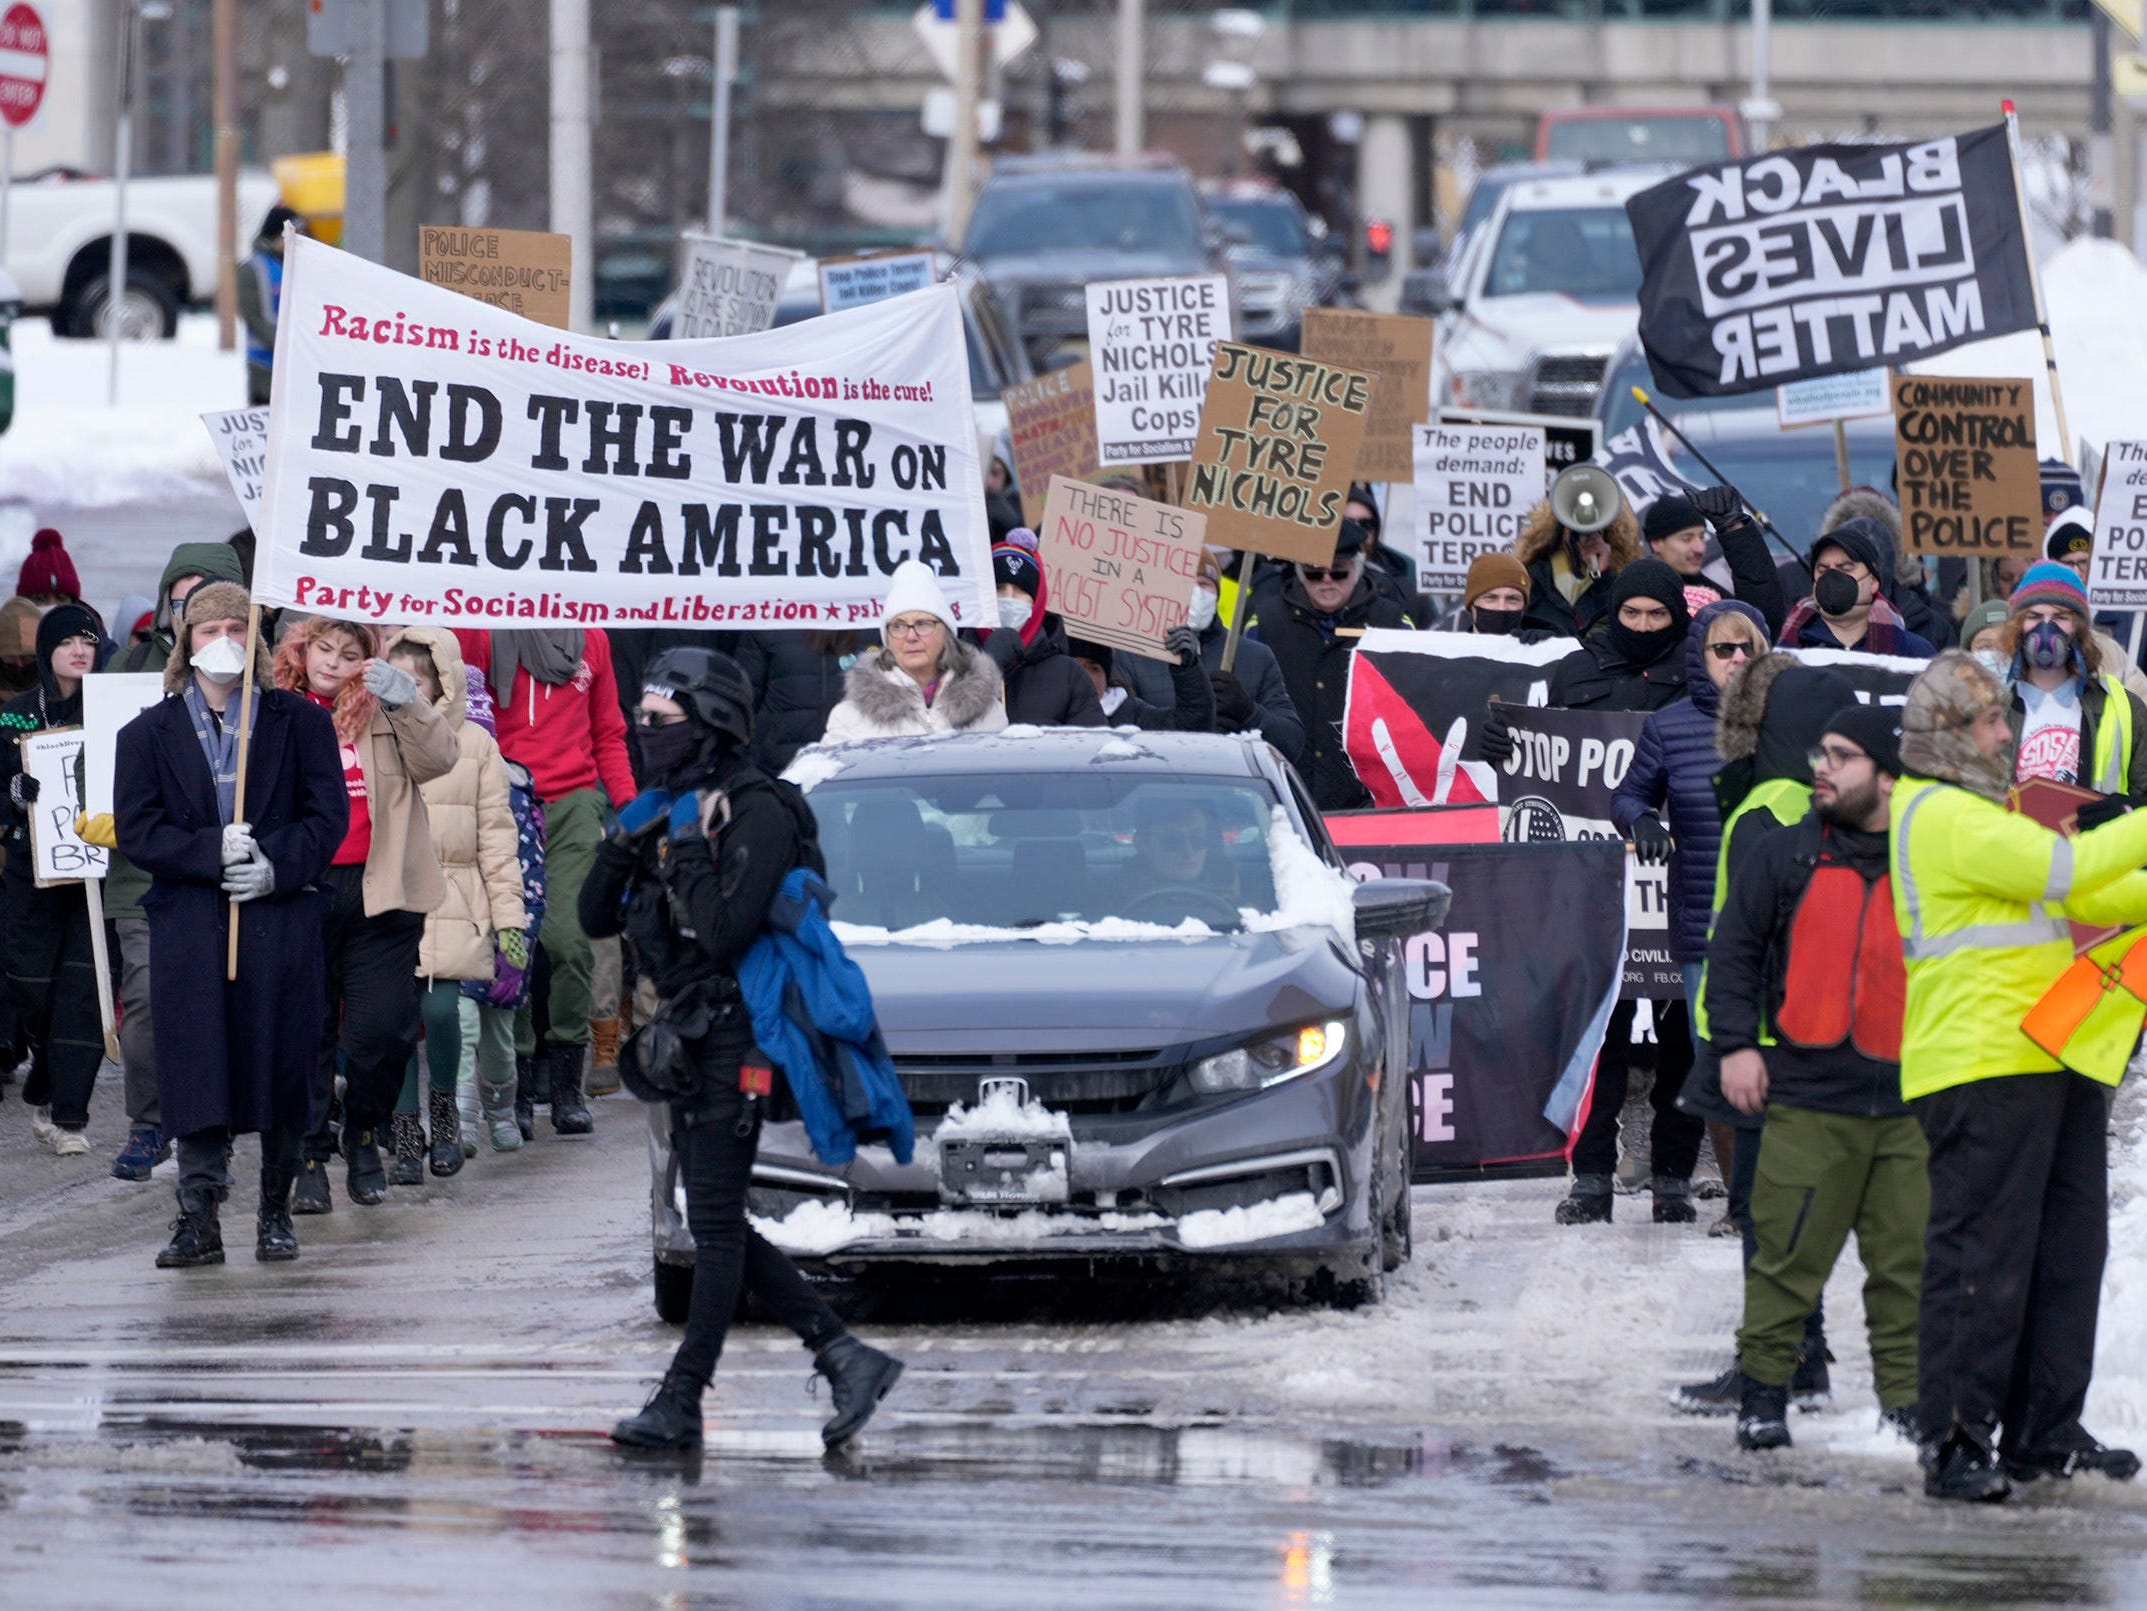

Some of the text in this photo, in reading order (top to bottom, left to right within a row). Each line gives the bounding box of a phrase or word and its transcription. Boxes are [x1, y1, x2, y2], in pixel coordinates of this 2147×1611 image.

[424, 229, 499, 259] POLICE
[1100, 284, 1215, 315] JUSTICE
[1107, 313, 1211, 346] for TYRE
[319, 304, 933, 402] Racism is the disease! Revolution is the cure!
[1102, 341, 1216, 372] NICHOLS
[1103, 378, 1148, 404] Jail
[1216, 346, 1369, 412] JUSTICE
[1897, 382, 2022, 408] COMMUNITY
[311, 372, 947, 491] END THE WAR ON
[1248, 395, 1320, 441] FOR
[1900, 410, 2036, 449] CONTROL
[1213, 428, 1327, 484] TYRE
[1423, 430, 1538, 454] The people
[1436, 455, 1525, 475] demand:
[1904, 449, 1996, 481] OVER
[1063, 485, 1184, 539] THERE IS
[1191, 464, 1342, 528] NICHOLS
[1448, 481, 1512, 508] END
[1904, 480, 1972, 511] THE
[300, 476, 961, 578] BLACK AMERICA
[1910, 510, 2032, 548] POLICE
[1056, 515, 1200, 579] NO JUSTICE
[1092, 557, 1145, 585] IN A
[293, 576, 394, 617] Party
[400, 594, 438, 615] for
[443, 588, 608, 623] Socialism
[615, 602, 658, 621] and
[662, 595, 818, 621] Liberation
[1118, 588, 1190, 641] SYSTEM
[1503, 726, 1570, 783] STOP
